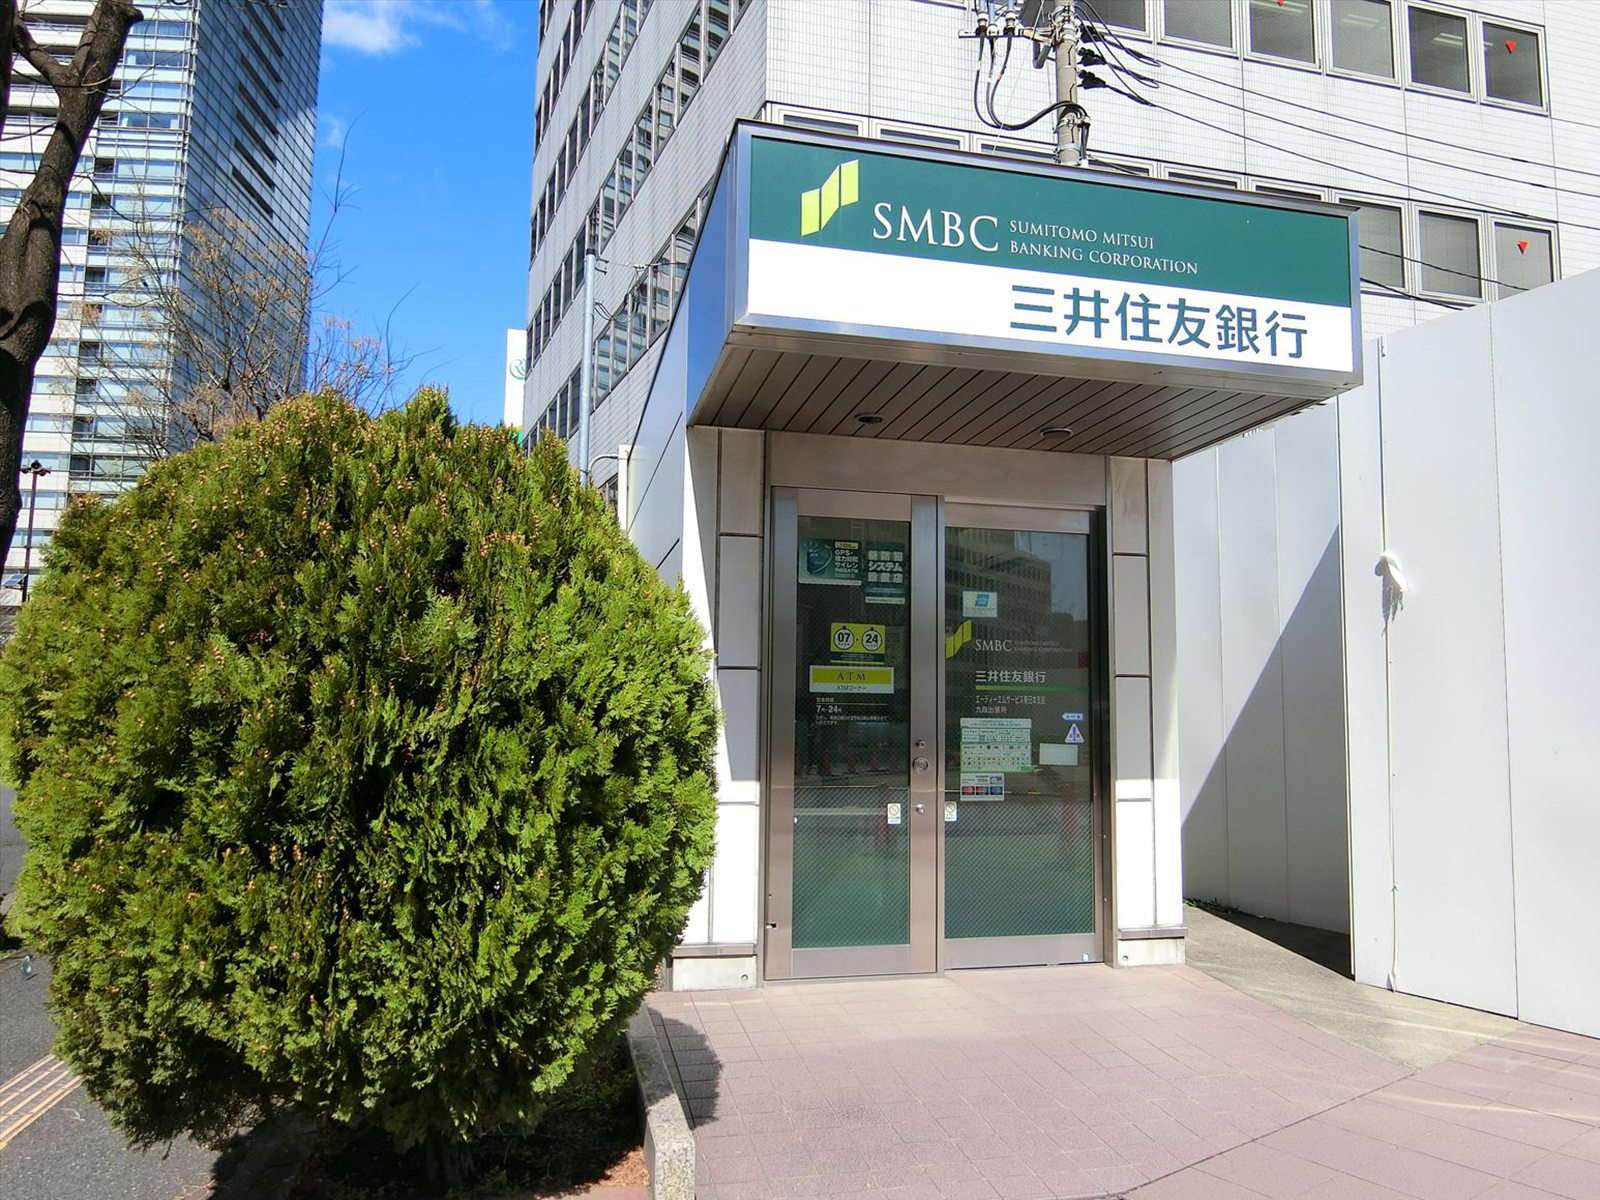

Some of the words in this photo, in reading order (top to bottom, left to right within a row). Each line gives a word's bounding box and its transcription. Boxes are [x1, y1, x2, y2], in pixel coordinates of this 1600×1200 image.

[872, 202, 999, 252] SMBC
[1009, 219, 1097, 242] SUMITOMO
[1102, 231, 1154, 250] MITSUI
[1010, 240, 1083, 261] BANKING
[1088, 250, 1198, 275] CORPORATION
[1010, 284, 1308, 359] 三井住友銀行
[868, 561, 903, 572] システム
[838, 632, 851, 642] 07
[865, 633, 878, 644] 24
[975, 639, 1012, 652] SMBC
[837, 672, 866, 681] ATM
[975, 670, 1047, 683] 三井住友銀行
